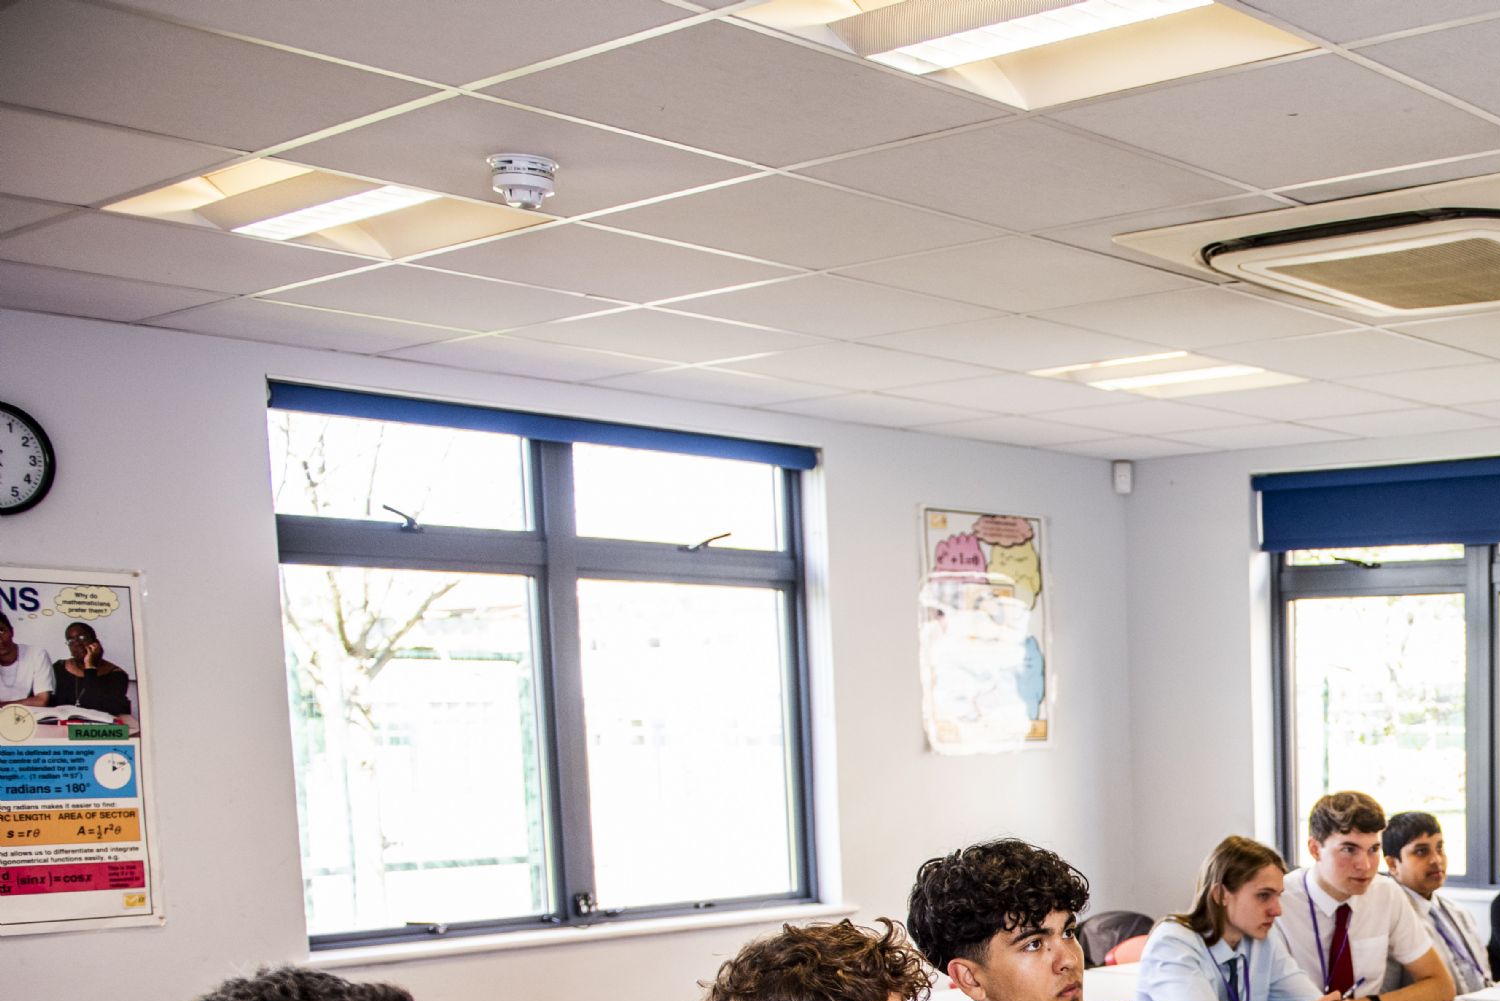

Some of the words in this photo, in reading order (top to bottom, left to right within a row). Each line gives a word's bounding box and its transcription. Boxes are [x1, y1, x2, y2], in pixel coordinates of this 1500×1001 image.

[7, 422, 13, 433] 1
[22, 436, 30, 447] 2
[29, 456, 38, 467] 3
[24, 473, 32, 484] 4
[11, 486, 20, 498] 5
[74, 592, 88, 600] Why
[75, 728, 123, 738] RADIANS
[6, 783, 51, 794] radians
[41, 802, 63, 810] makes
[13, 813, 51, 822] LENGTH
[58, 812, 82, 820] AREA
[84, 811, 97, 820] OF
[100, 810, 136, 819] SECTOR
[54, 847, 94, 855] differentiate
[50, 856, 82, 864] functions
